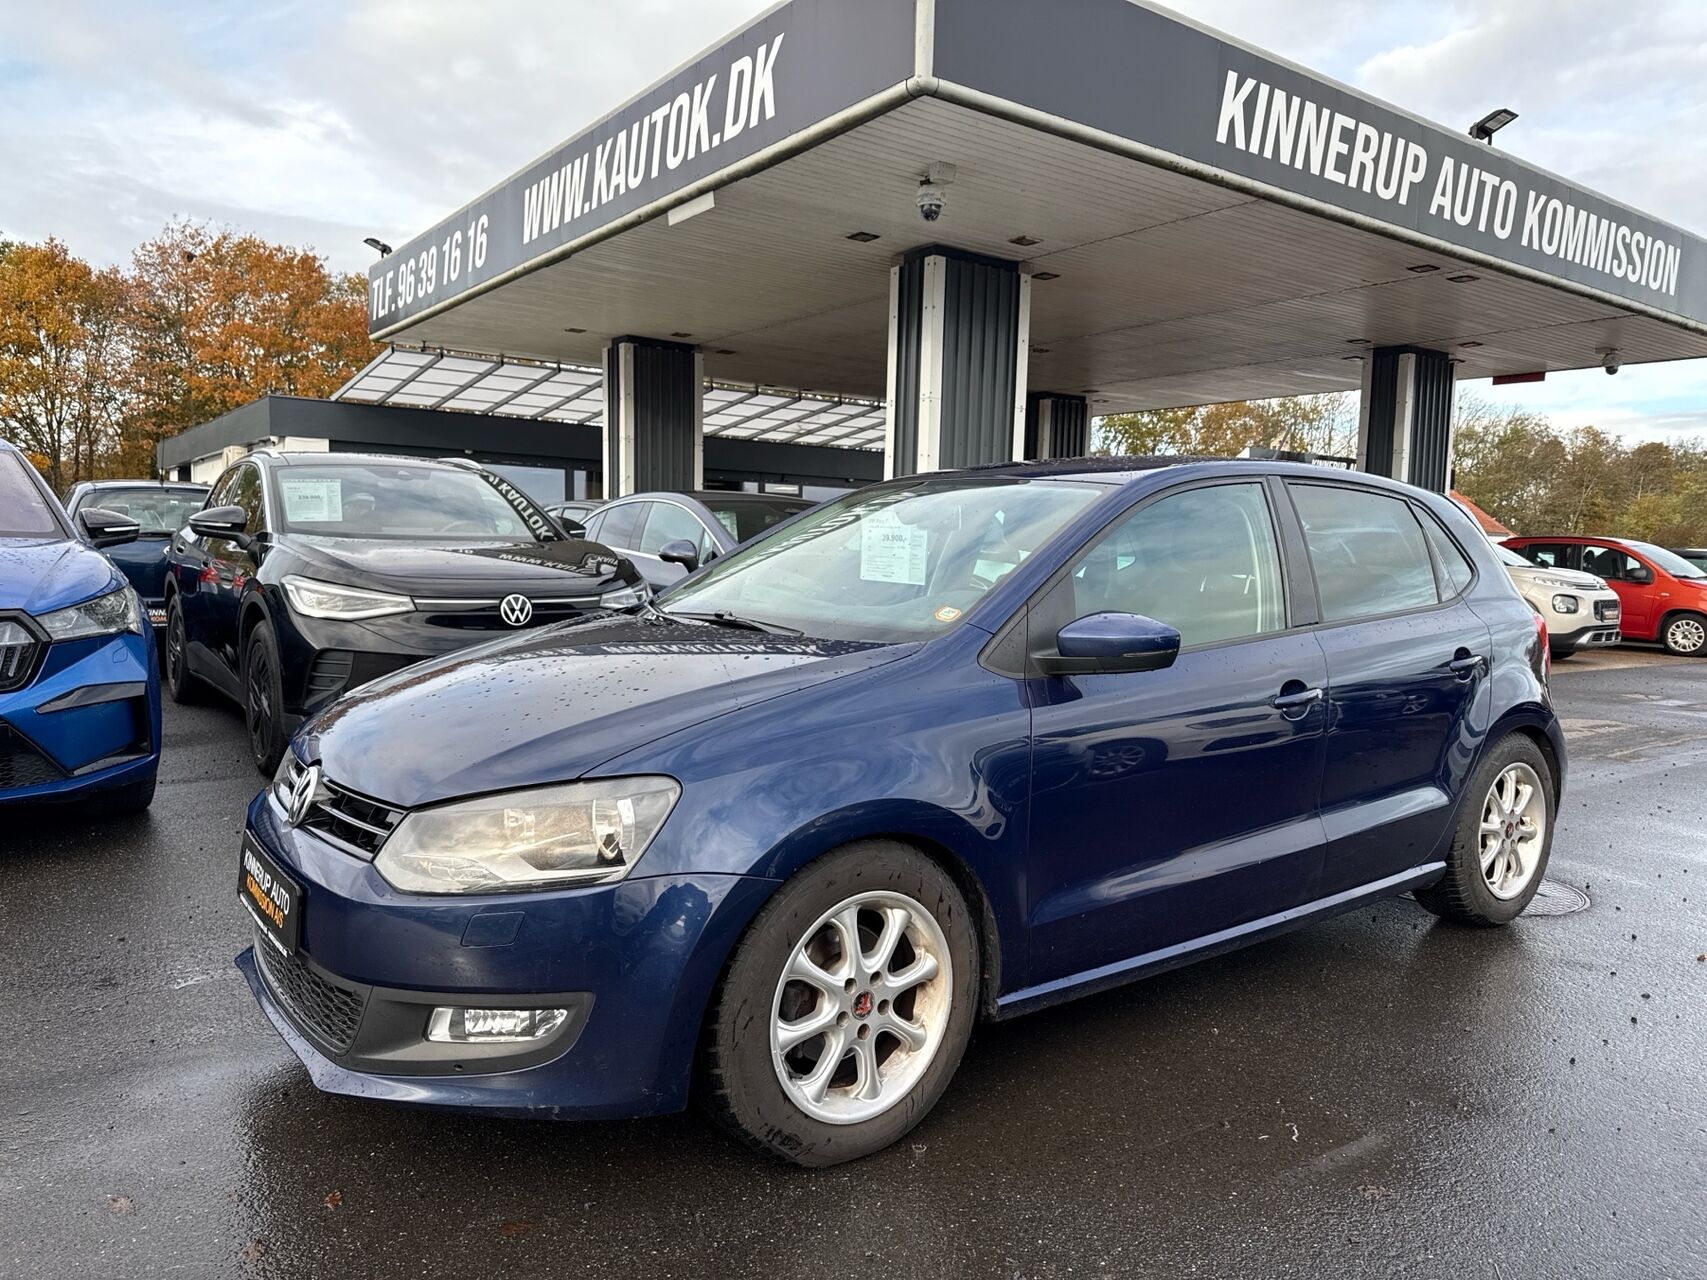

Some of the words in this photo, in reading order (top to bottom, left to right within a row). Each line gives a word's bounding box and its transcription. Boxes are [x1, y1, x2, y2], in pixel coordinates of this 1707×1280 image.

[523, 32, 785, 245] WWW.KAUTOK.DK
[1216, 69, 1427, 206] KINNERUP
[1429, 156, 1517, 240] AUTO
[1521, 190, 1681, 297] KOMMISSION
[372, 270, 396, 319] TLF.
[397, 258, 415, 308] 96
[417, 244, 437, 299] 39
[442, 230, 462, 286] 16
[467, 214, 489, 272] 16
[270, 880, 290, 916] AUTO
